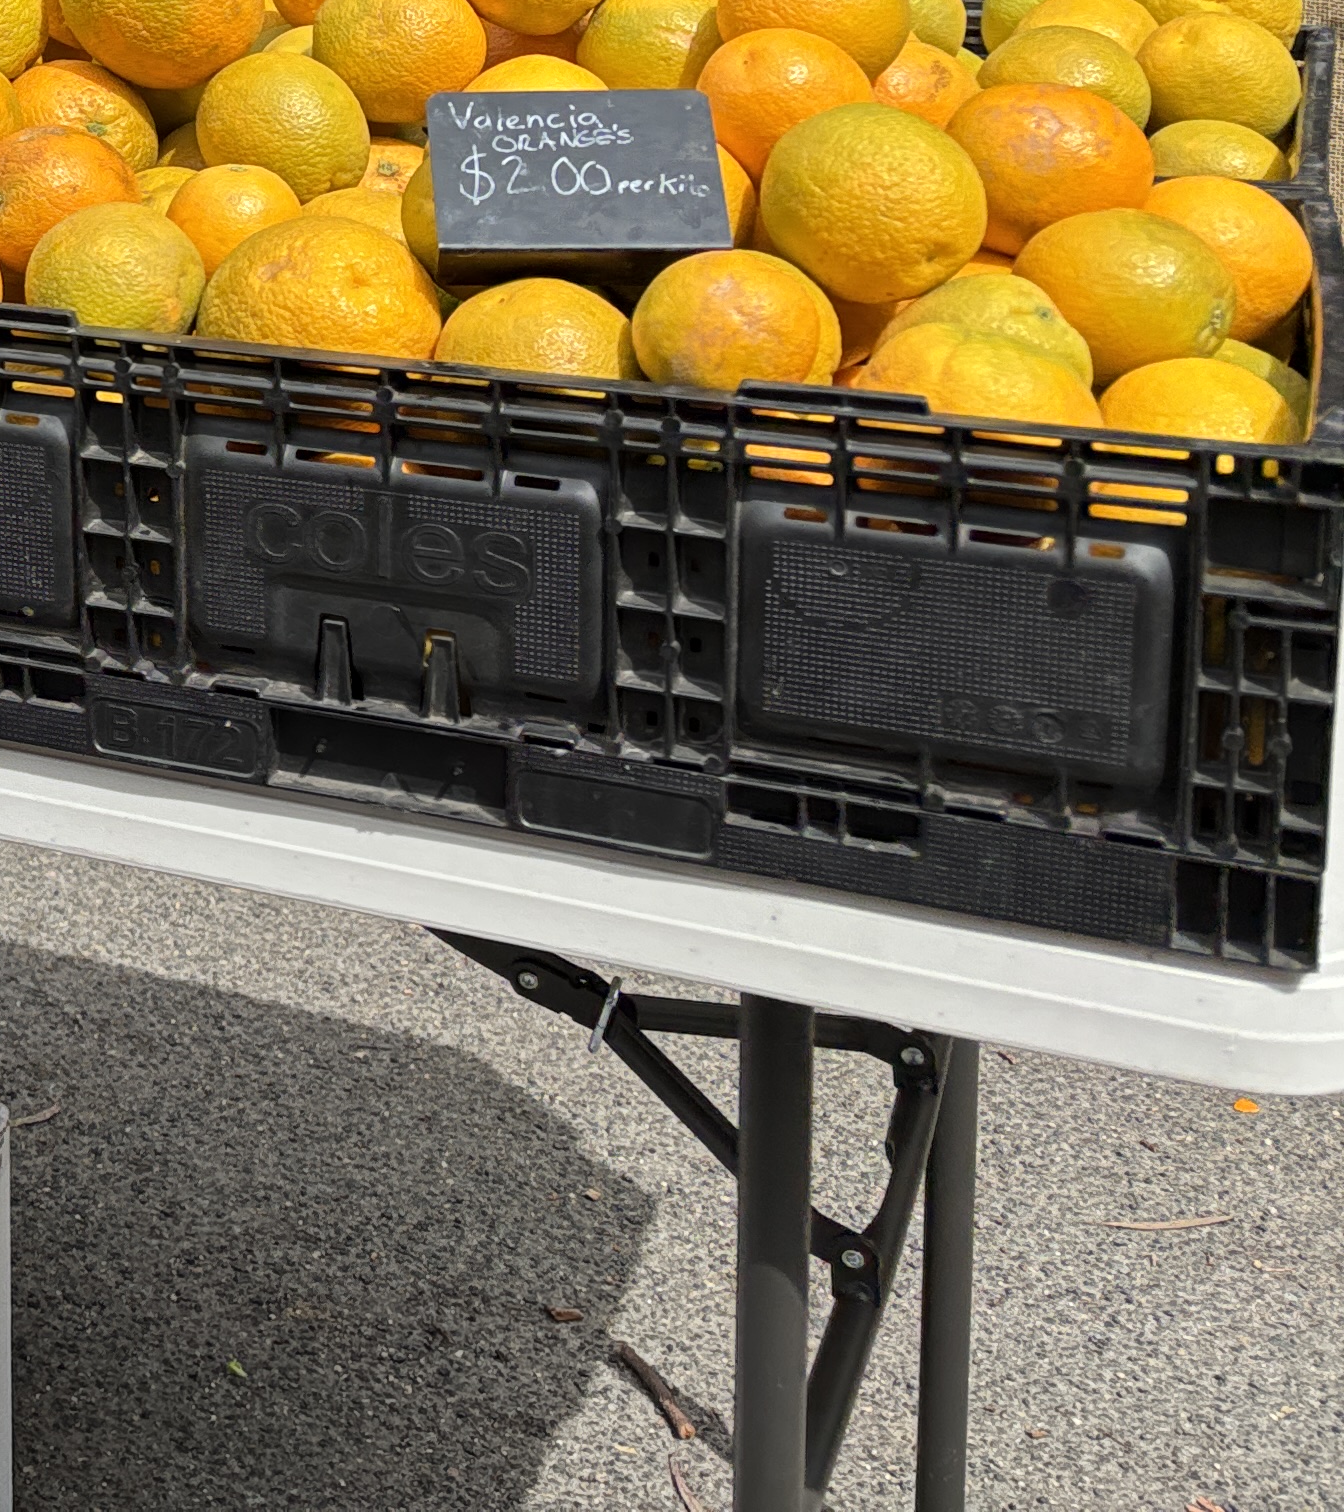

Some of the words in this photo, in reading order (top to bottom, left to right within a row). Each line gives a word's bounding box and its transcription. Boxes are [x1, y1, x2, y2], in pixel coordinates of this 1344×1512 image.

[448, 101, 604, 131] Valencia
[617, 179, 654, 194] per
[244, 492, 534, 596] coles
